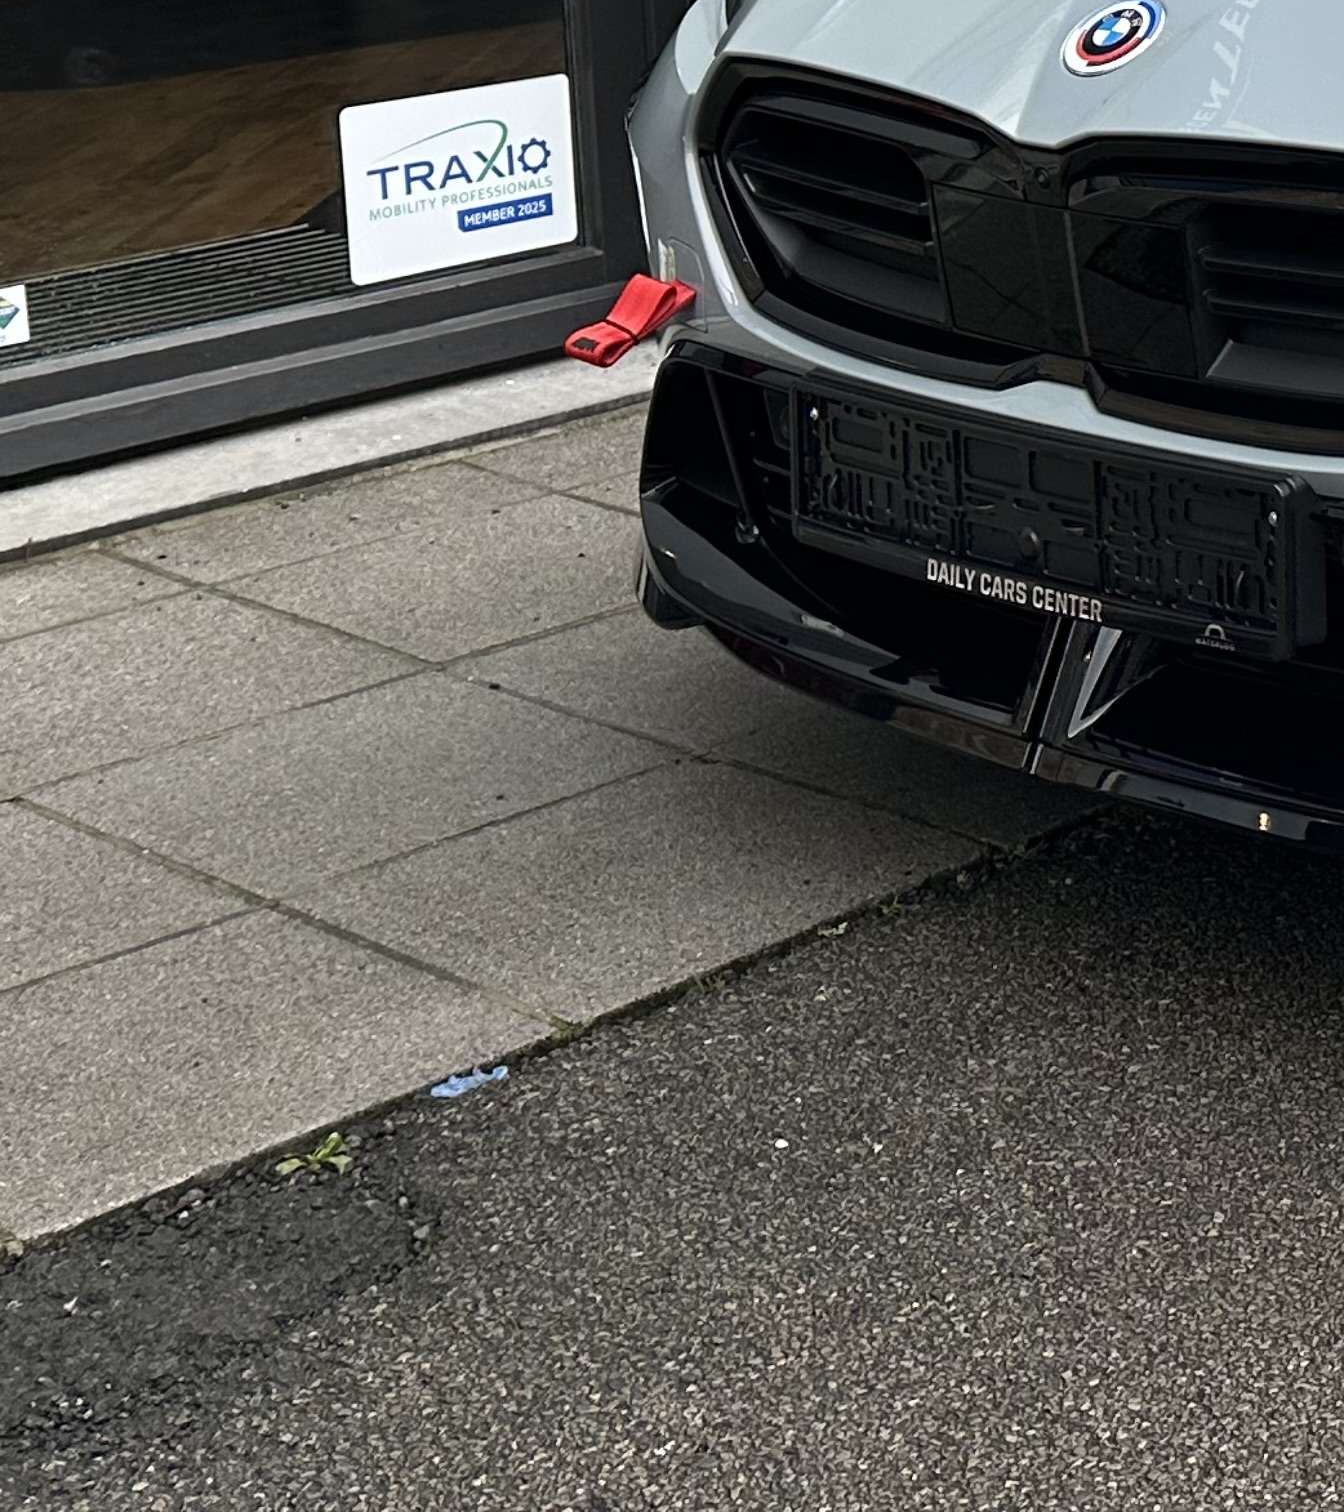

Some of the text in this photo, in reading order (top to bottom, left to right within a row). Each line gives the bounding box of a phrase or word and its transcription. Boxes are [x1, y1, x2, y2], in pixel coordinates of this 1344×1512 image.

[367, 138, 551, 200] TRAXIO
[368, 176, 553, 222] MOBILITY PROFESSIONALS
[463, 200, 546, 227] MEMBER 2025
[927, 558, 1103, 623] DAILY CARS CENTER
